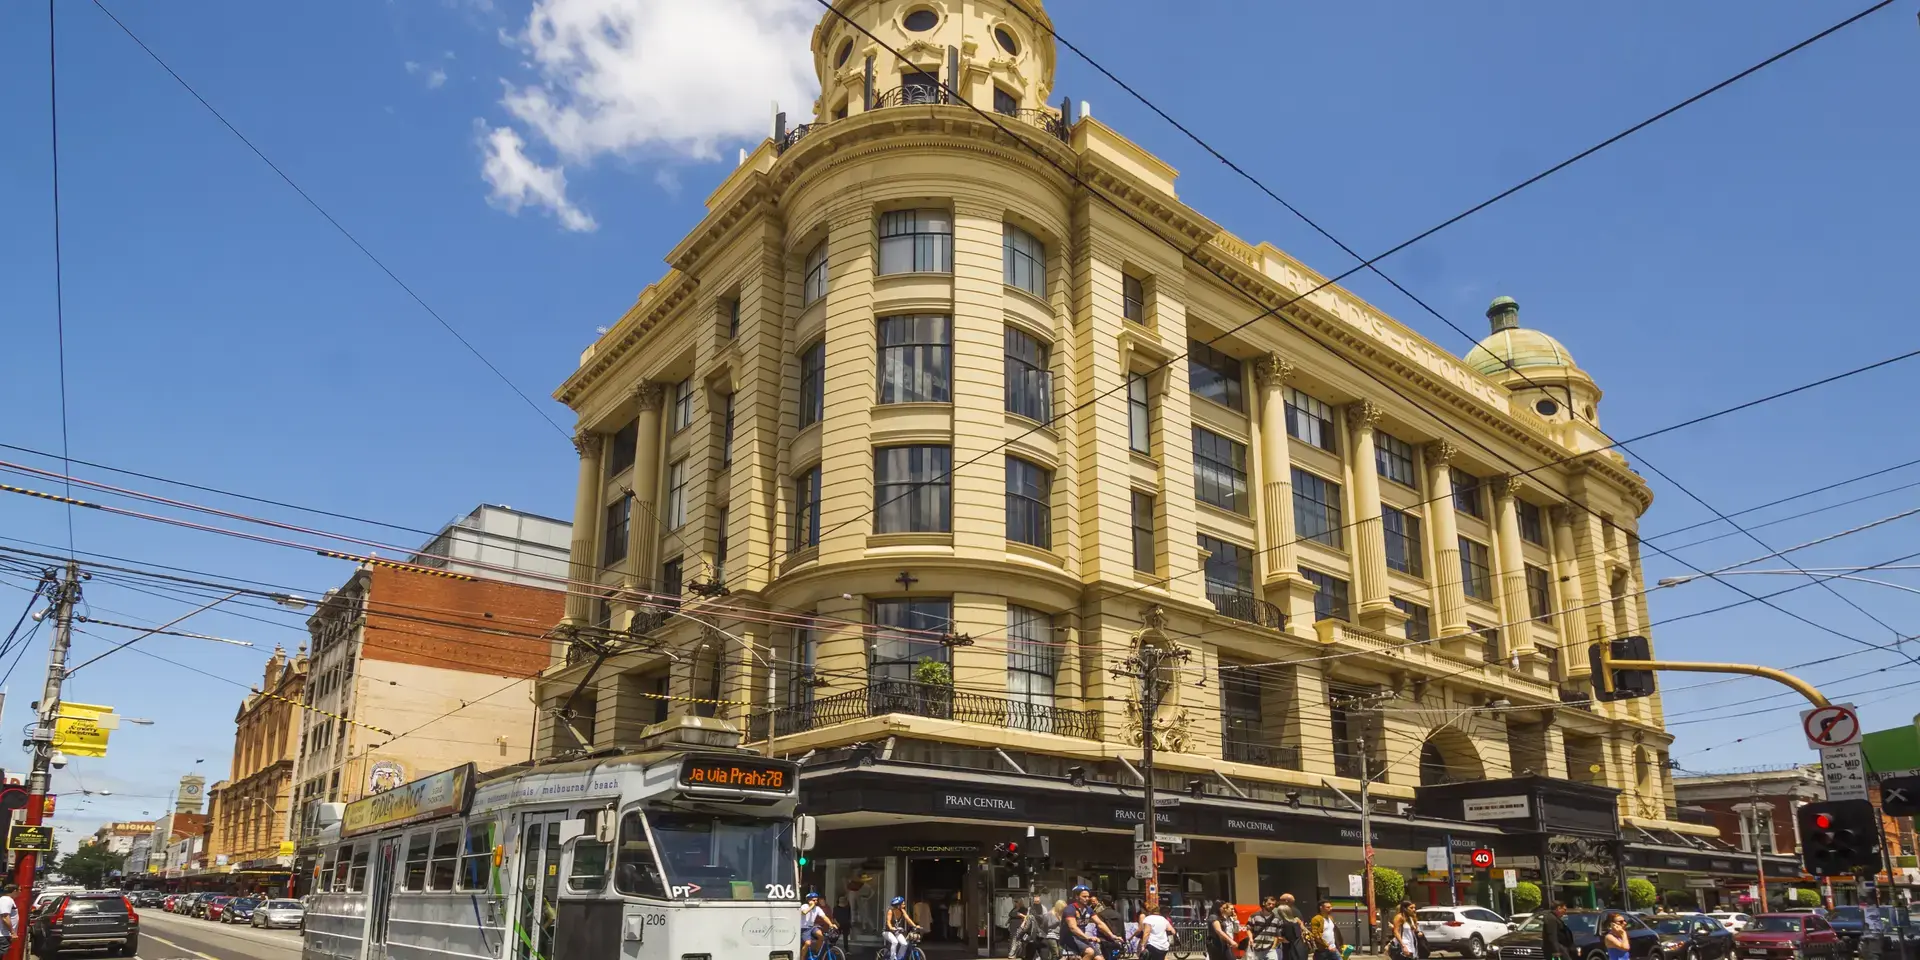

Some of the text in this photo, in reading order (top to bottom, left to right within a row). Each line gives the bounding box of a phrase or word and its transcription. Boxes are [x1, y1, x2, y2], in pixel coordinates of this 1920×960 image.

[707, 767, 727, 783] via
[542, 784, 585, 795] melbourne
[594, 779, 619, 790] beach
[945, 795, 1016, 810] PRAN CENTRAL
[1115, 809, 1136, 819] PRAN
[1228, 820, 1275, 832] PRAN CENTRAL
[1341, 829, 1356, 838] PRAN
[1450, 839, 1461, 847] OOD
[1475, 854, 1489, 863] 40
[765, 884, 795, 899] 206
[646, 914, 666, 926] 206
